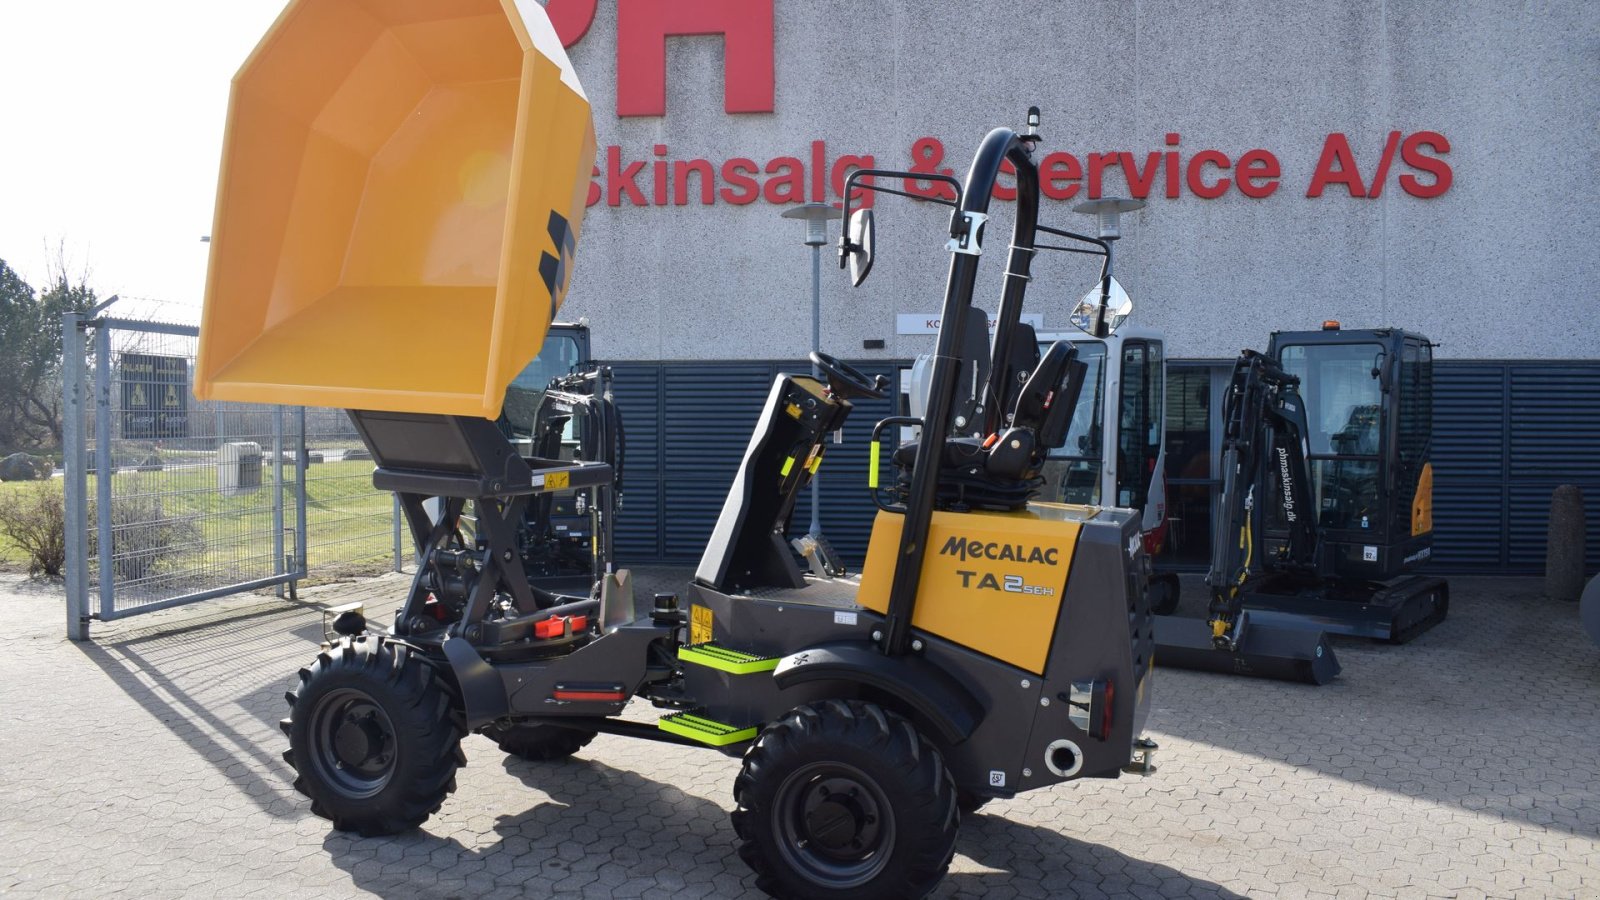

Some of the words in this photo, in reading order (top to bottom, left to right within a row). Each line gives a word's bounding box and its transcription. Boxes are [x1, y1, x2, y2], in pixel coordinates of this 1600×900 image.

[903, 137, 957, 201] &
[1306, 130, 1453, 200] A/S
[1276, 447, 1297, 522] phmaskinsalg.dk
